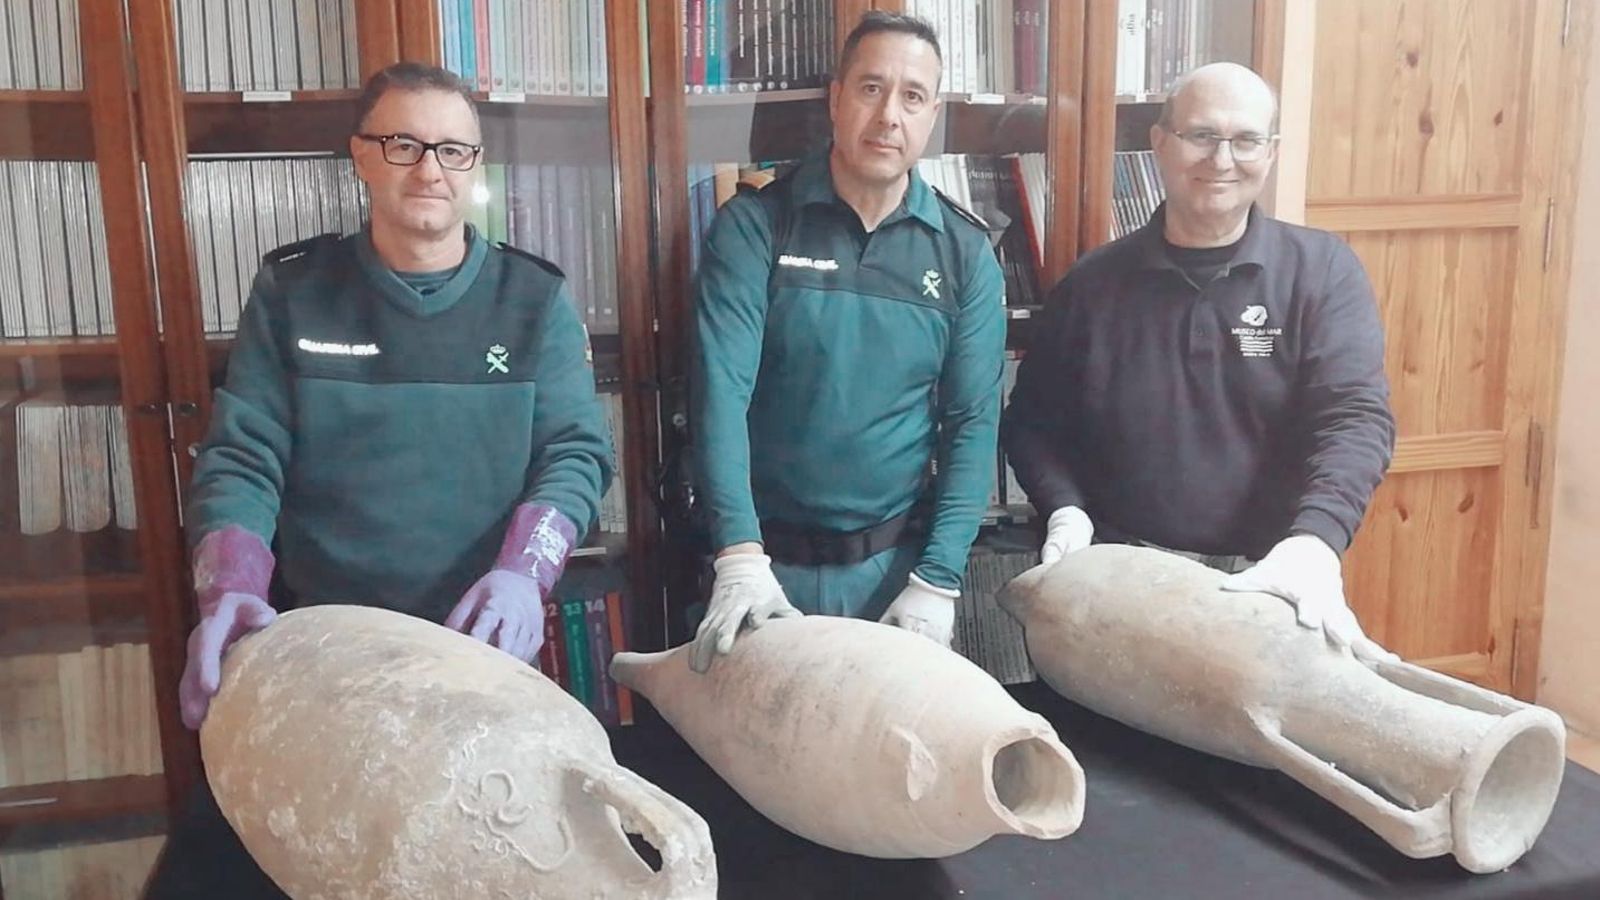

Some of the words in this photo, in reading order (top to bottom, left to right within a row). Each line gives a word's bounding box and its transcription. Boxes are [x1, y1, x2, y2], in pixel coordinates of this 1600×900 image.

[1231, 327, 1256, 336] MUSEO
[1266, 327, 1282, 335] MAR
[298, 338, 351, 355] GUARDIA
